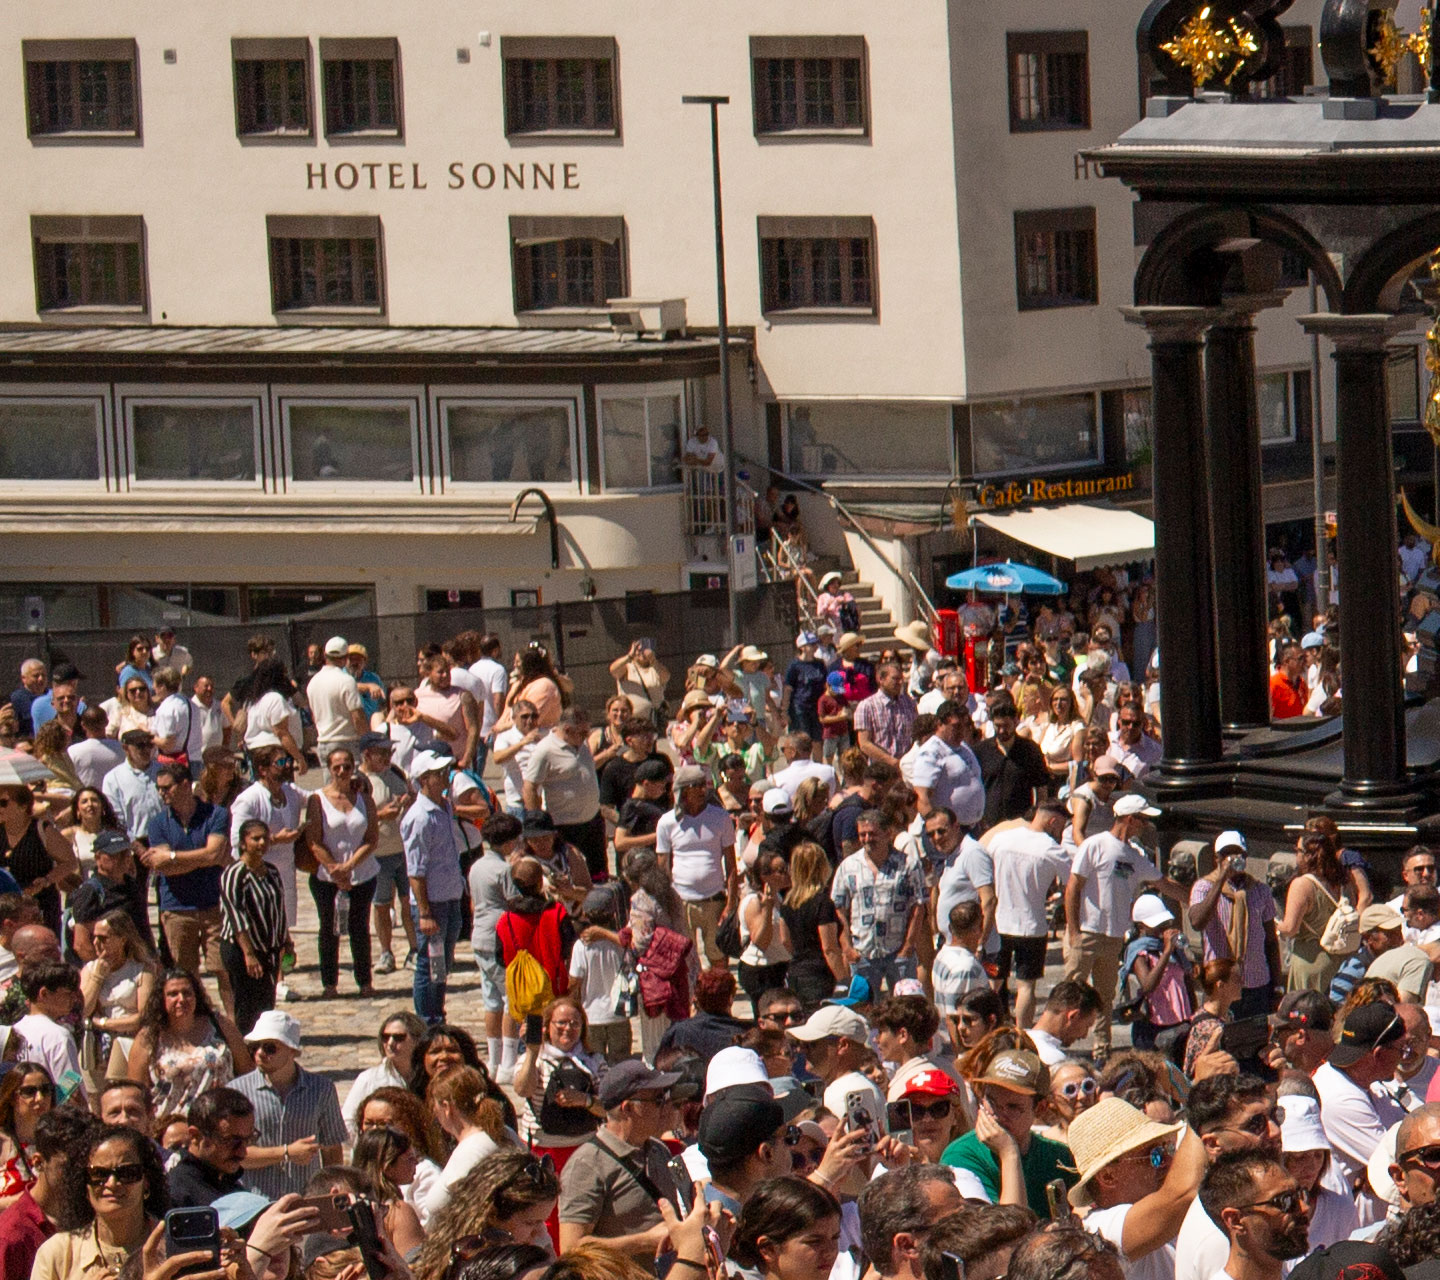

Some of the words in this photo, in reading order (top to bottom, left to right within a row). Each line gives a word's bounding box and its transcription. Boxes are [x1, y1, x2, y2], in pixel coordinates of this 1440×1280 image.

[306, 162, 428, 190] HOTEL
[448, 162, 580, 190] SONNE
[980, 482, 1022, 506] Cafe
[1032, 473, 1134, 502] Restaurant
